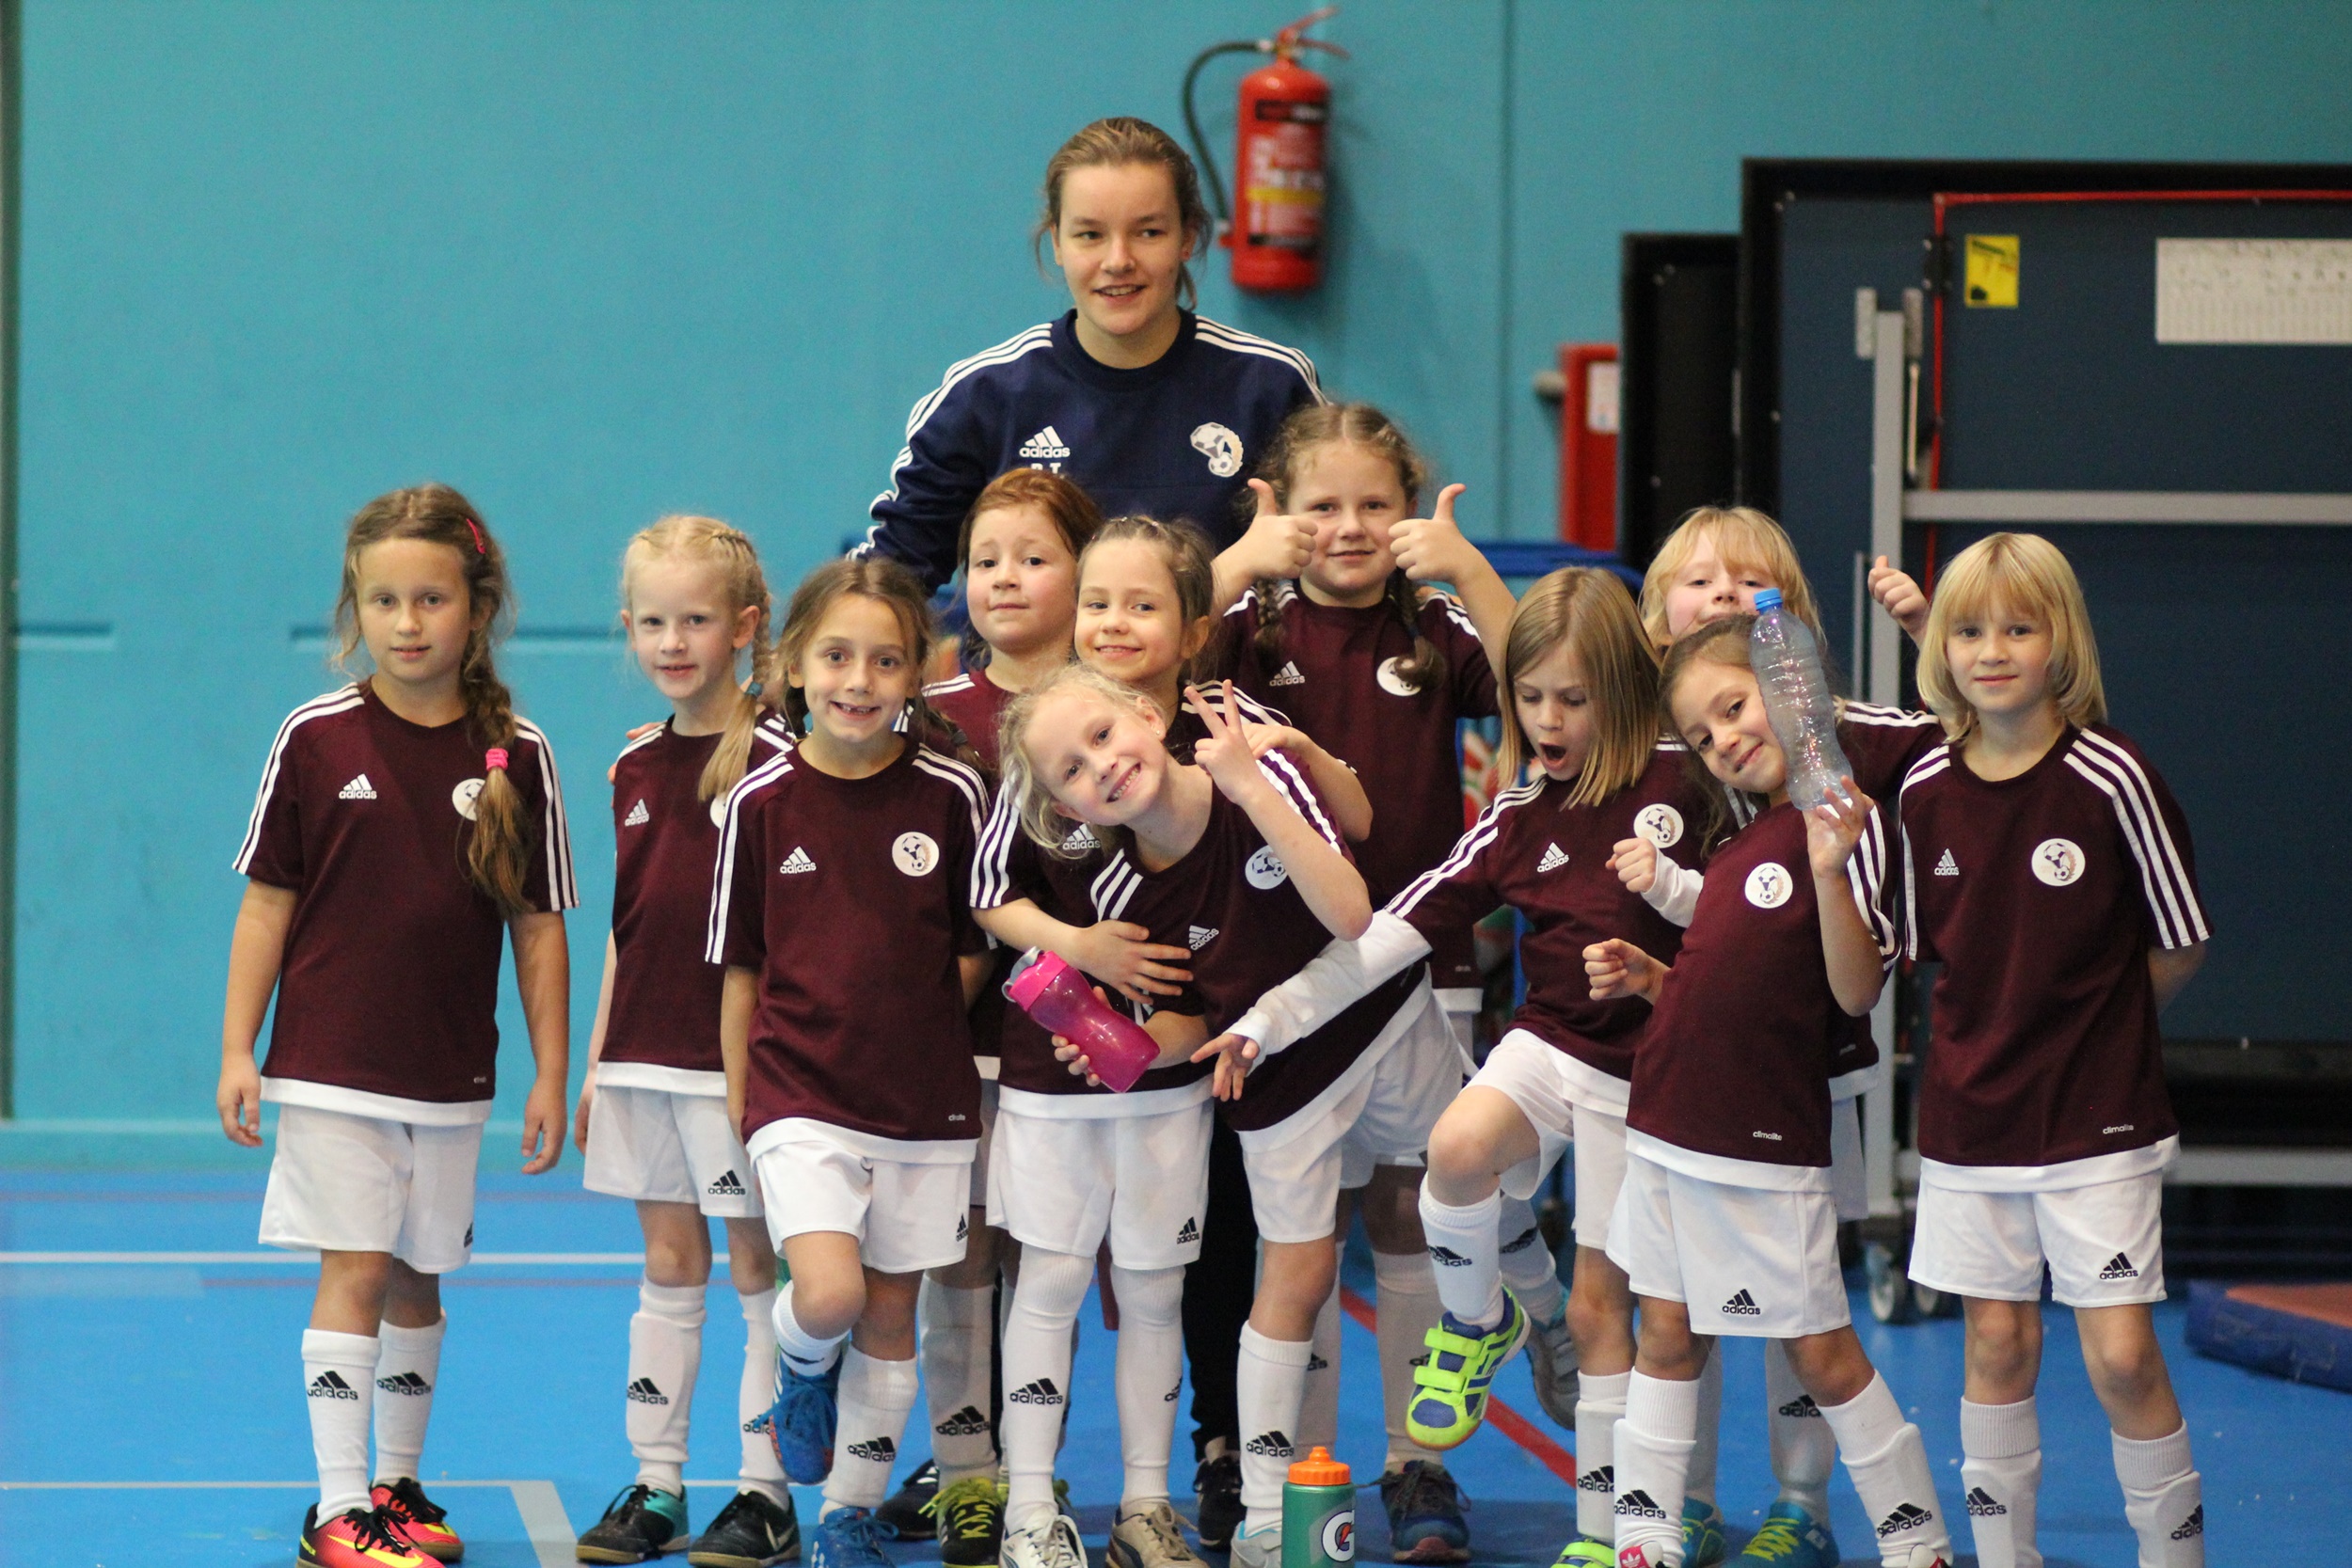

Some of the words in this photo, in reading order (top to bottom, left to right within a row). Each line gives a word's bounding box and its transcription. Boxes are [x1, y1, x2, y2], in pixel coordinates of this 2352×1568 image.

[1019, 446, 1071, 458] adidas
[1270, 674, 1305, 687] adidas
[339, 789, 377, 800] adidas
[1062, 839, 1102, 850] adidas
[780, 862, 817, 874] adidas
[1537, 854, 1569, 873] adidas
[1934, 865, 1960, 876] adidas
[1190, 928, 1219, 951] adidas
[707, 1185, 746, 1196] adidas
[2099, 1269, 2138, 1280] adidas
[1722, 1306, 1761, 1315] adidas
[1009, 1392, 1063, 1405] adidas
[1246, 1442, 1295, 1457] adidas
